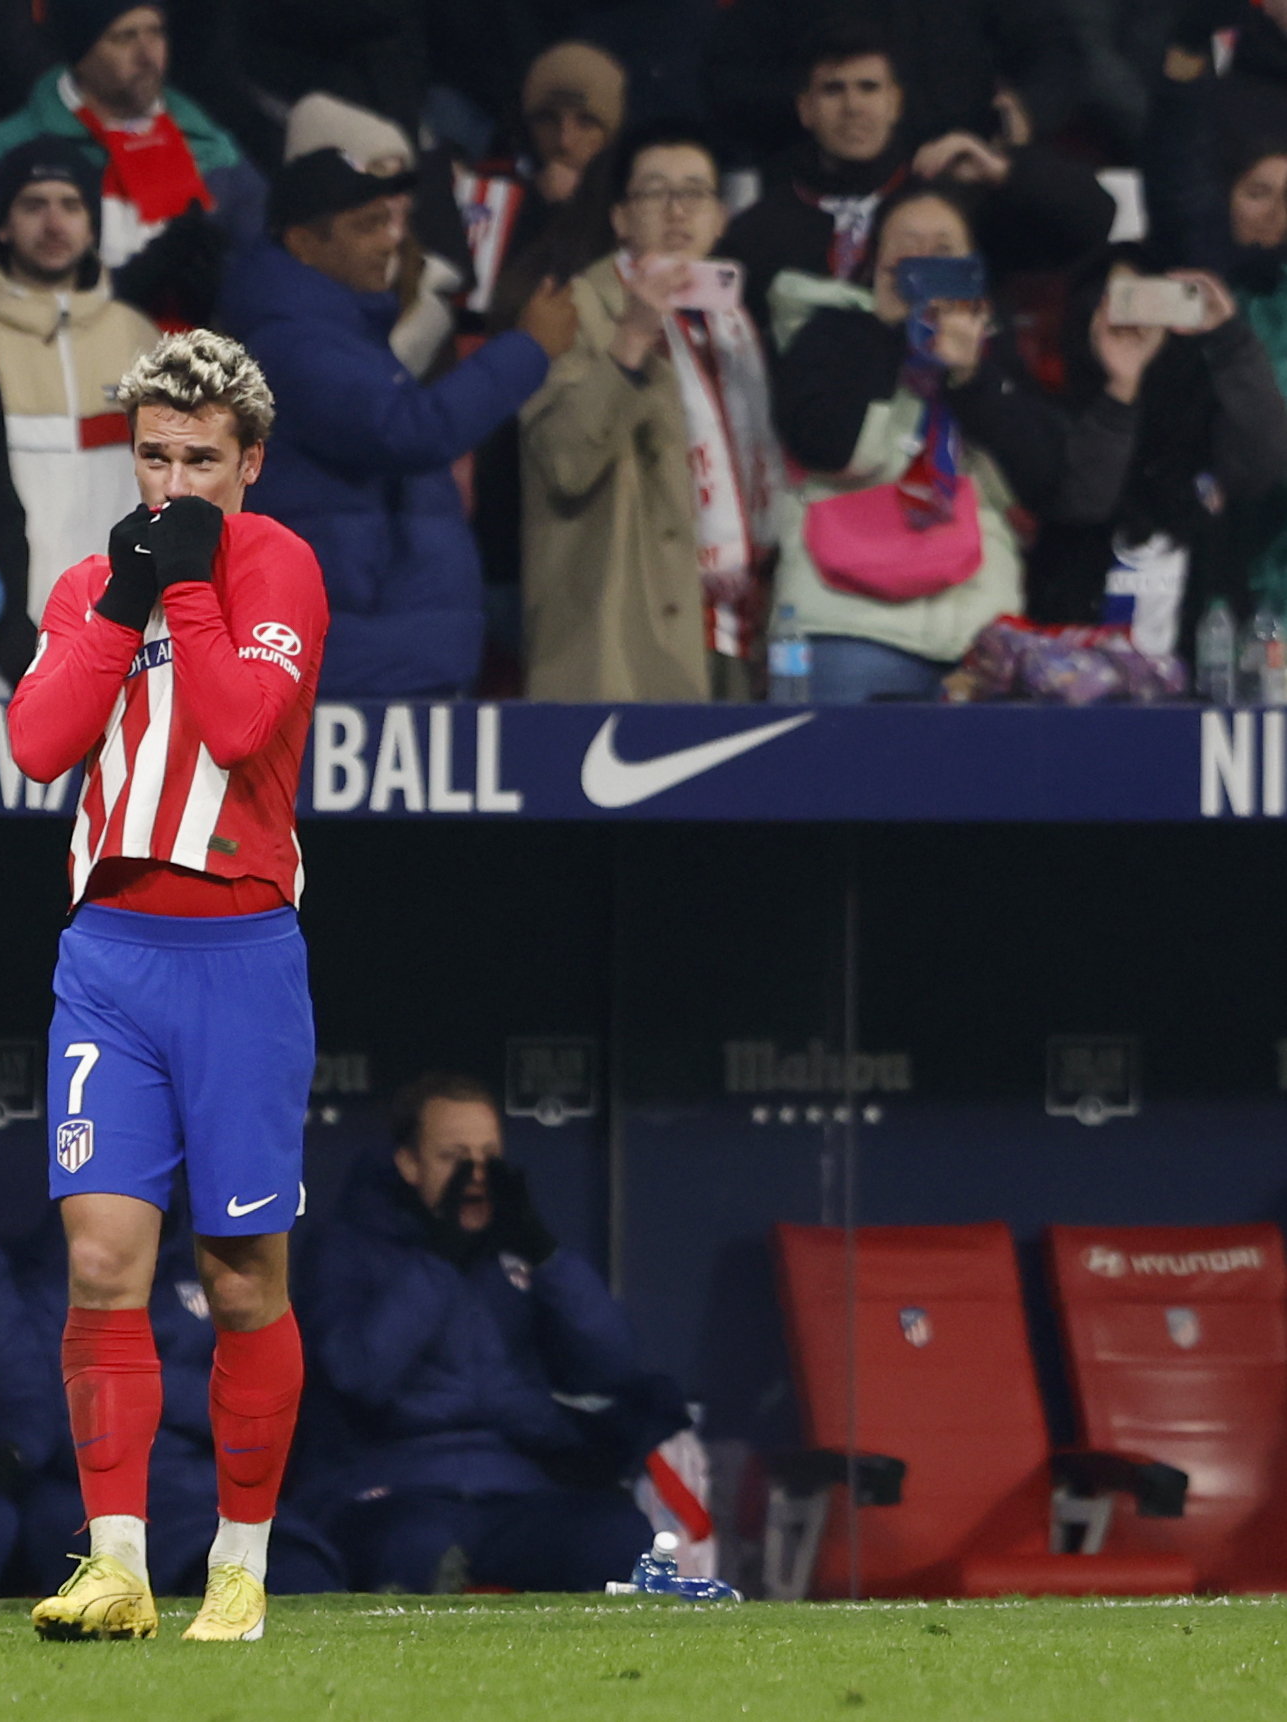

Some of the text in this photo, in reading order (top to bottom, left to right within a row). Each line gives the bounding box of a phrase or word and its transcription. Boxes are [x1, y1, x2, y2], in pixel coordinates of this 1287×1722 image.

[238, 646, 301, 684] HYUNDAI
[313, 703, 523, 813] BALL
[64, 1042, 100, 1115] 7
[723, 1040, 910, 1090] Mahou
[1129, 1246, 1262, 1276] HYUNDAI
